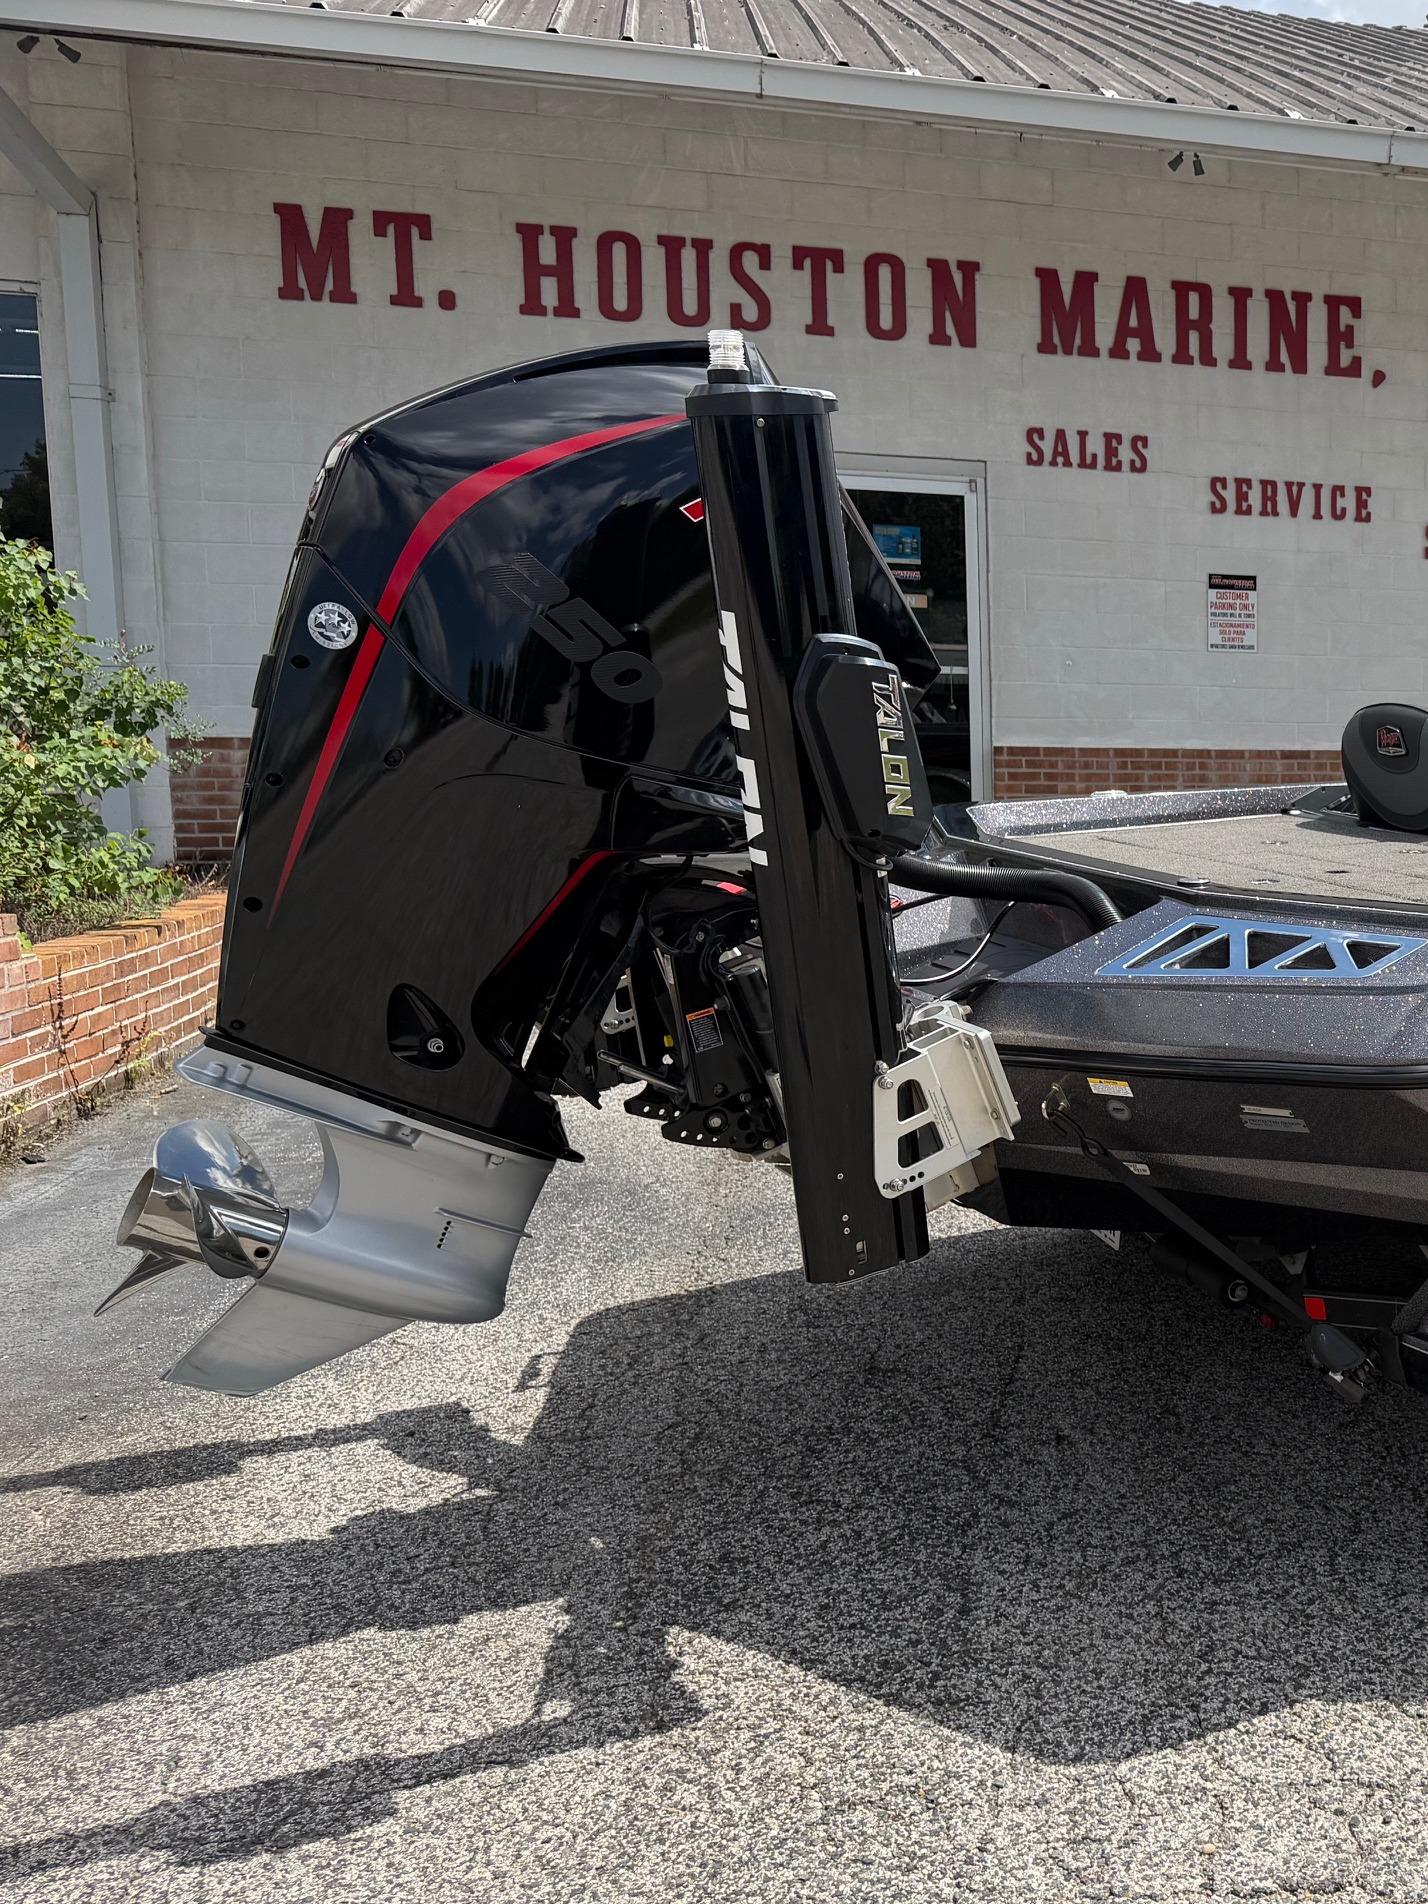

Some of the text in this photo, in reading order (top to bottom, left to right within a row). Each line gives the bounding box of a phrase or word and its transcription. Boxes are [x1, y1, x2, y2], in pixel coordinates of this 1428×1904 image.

[273, 202, 457, 311] MT.
[515, 222, 980, 348] HOUSTON
[1035, 266, 1386, 388] MARINE,
[1025, 427, 1149, 474] SALES
[1210, 476, 1372, 523] SERVICE
[1209, 602, 1255, 612] PARKING ONLY
[1215, 591, 1249, 601] CUSTOMER
[872, 674, 914, 816] TALON
